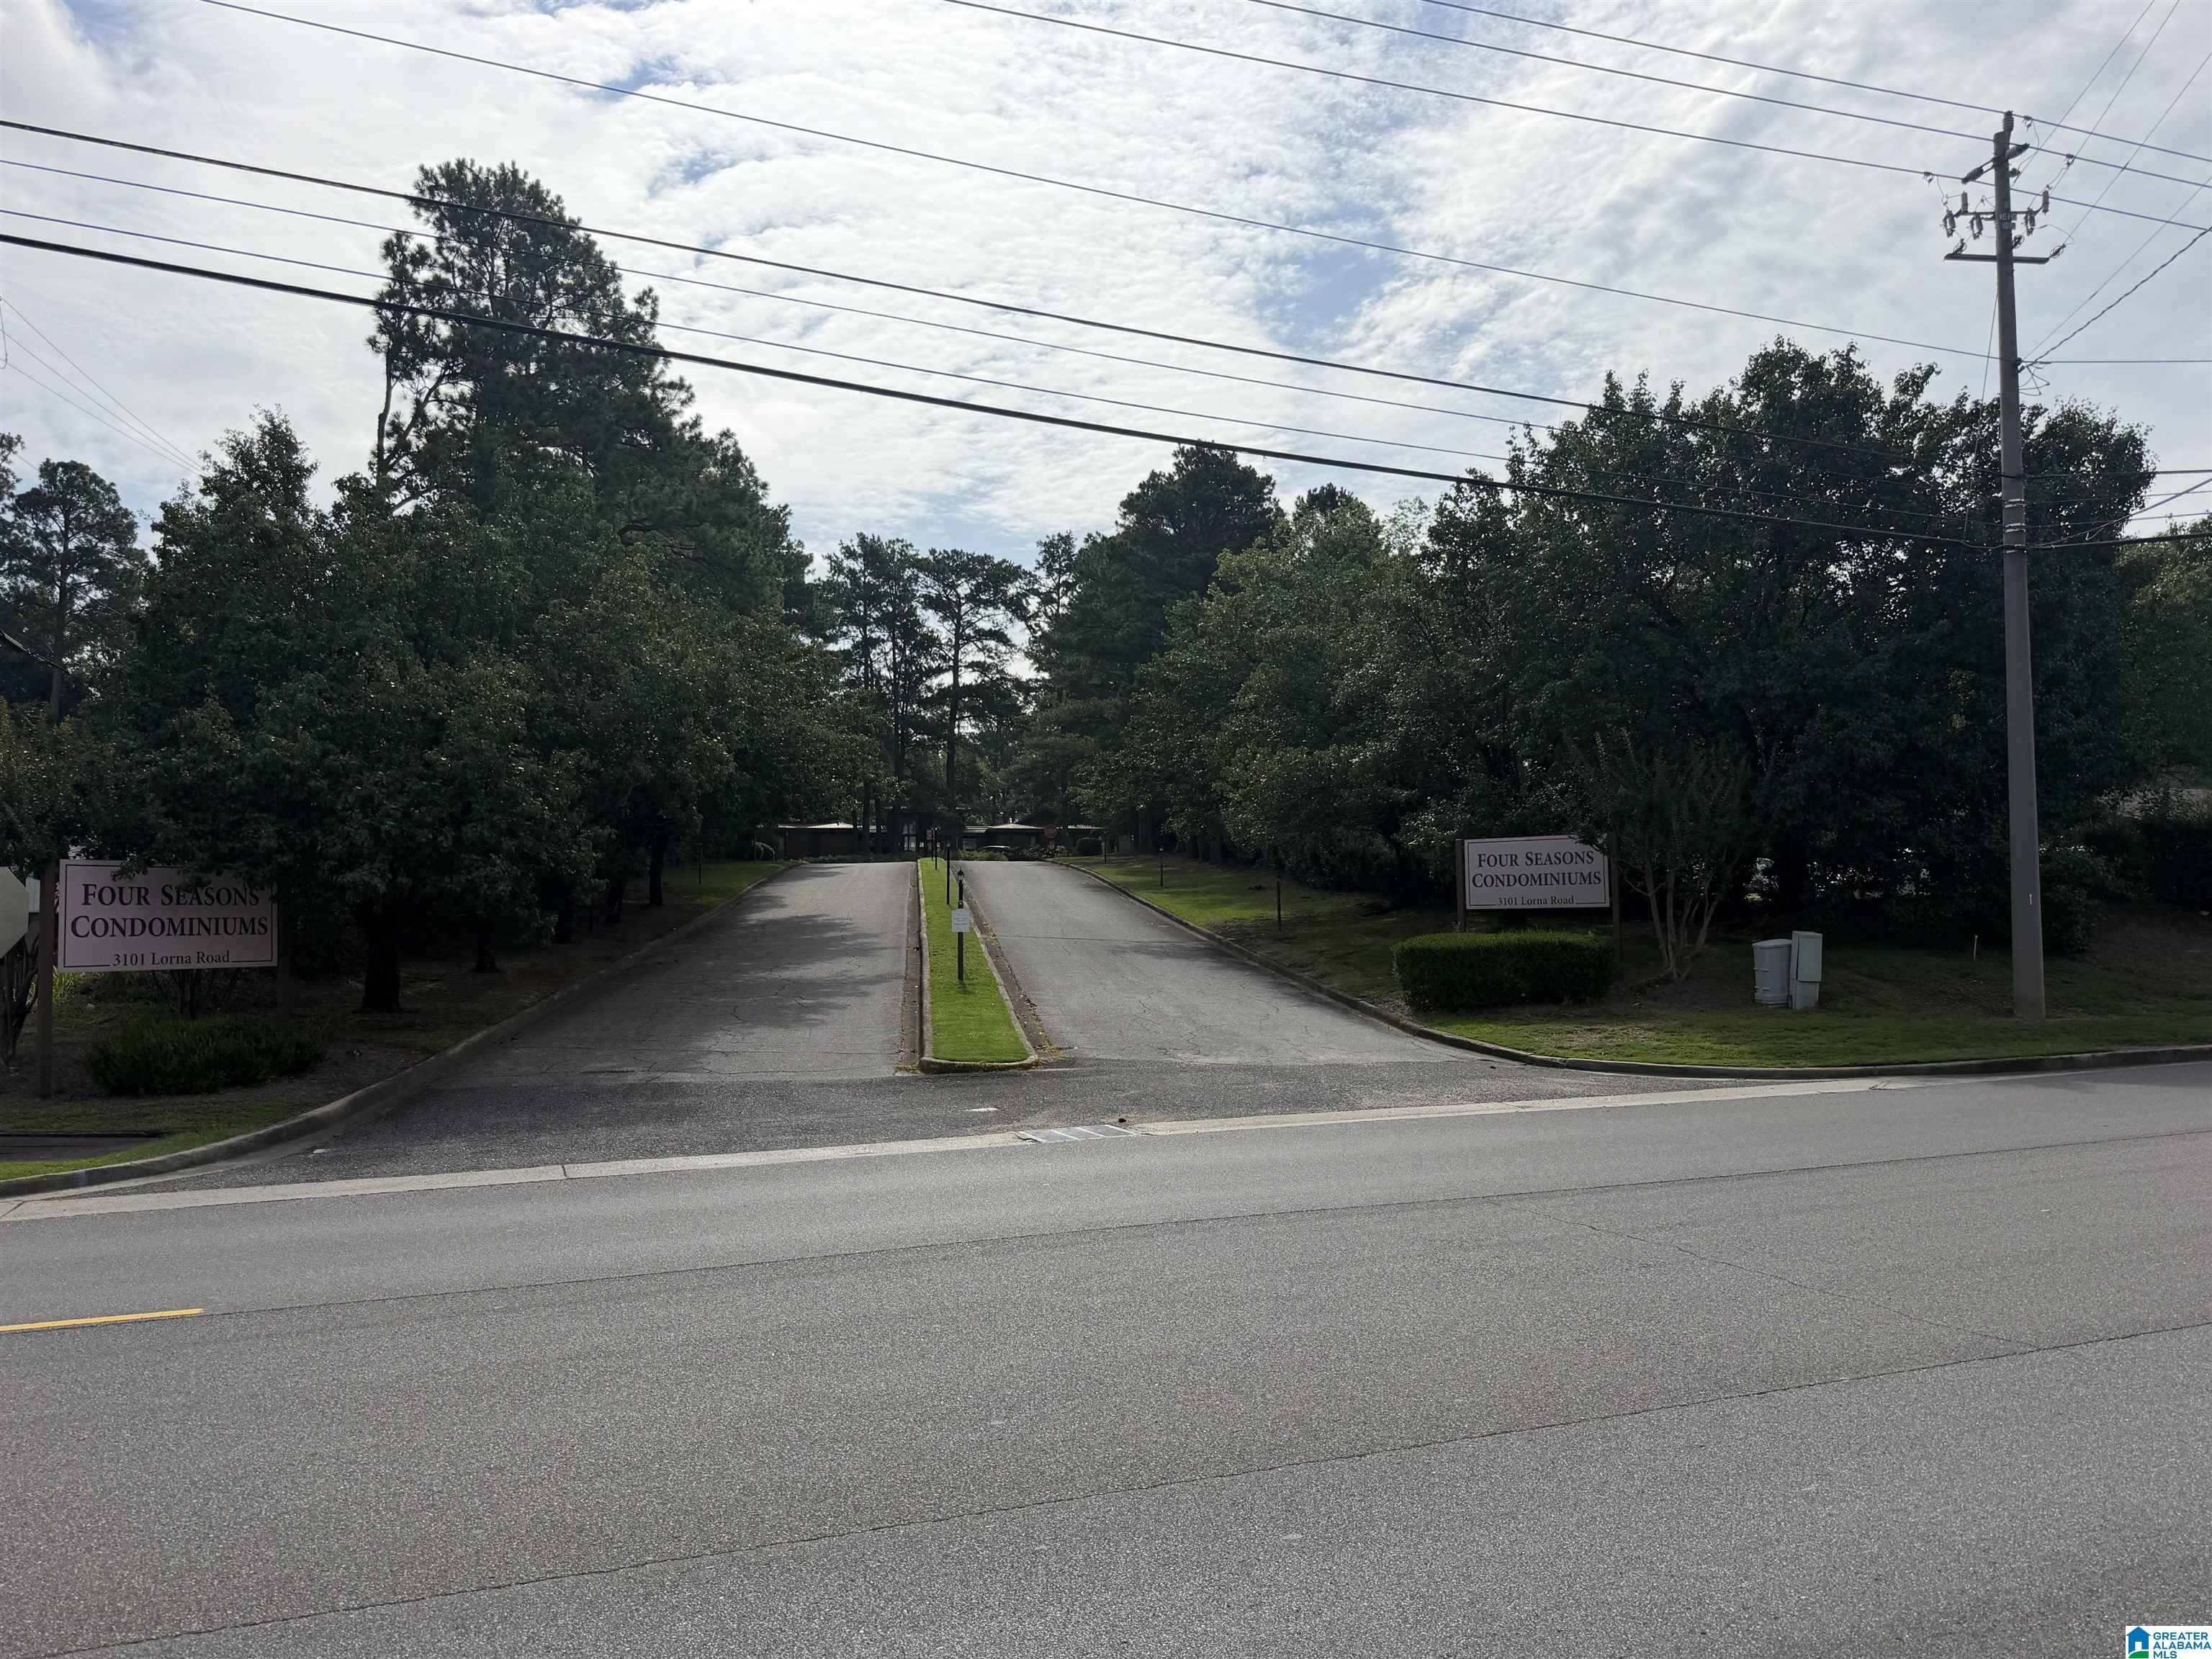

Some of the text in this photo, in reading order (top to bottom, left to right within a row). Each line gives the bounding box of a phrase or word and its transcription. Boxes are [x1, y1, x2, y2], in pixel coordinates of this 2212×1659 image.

[1477, 850, 1594, 868] FOUR SEASONS
[1472, 871, 1601, 888] CONDOMINIUMS
[81, 884, 260, 906] FOUR SEASONS
[1497, 895, 1574, 906] 3101 Lorna Road
[71, 915, 268, 938] CONDOMINIUMS
[112, 950, 230, 966] 3101 Lorna Road
